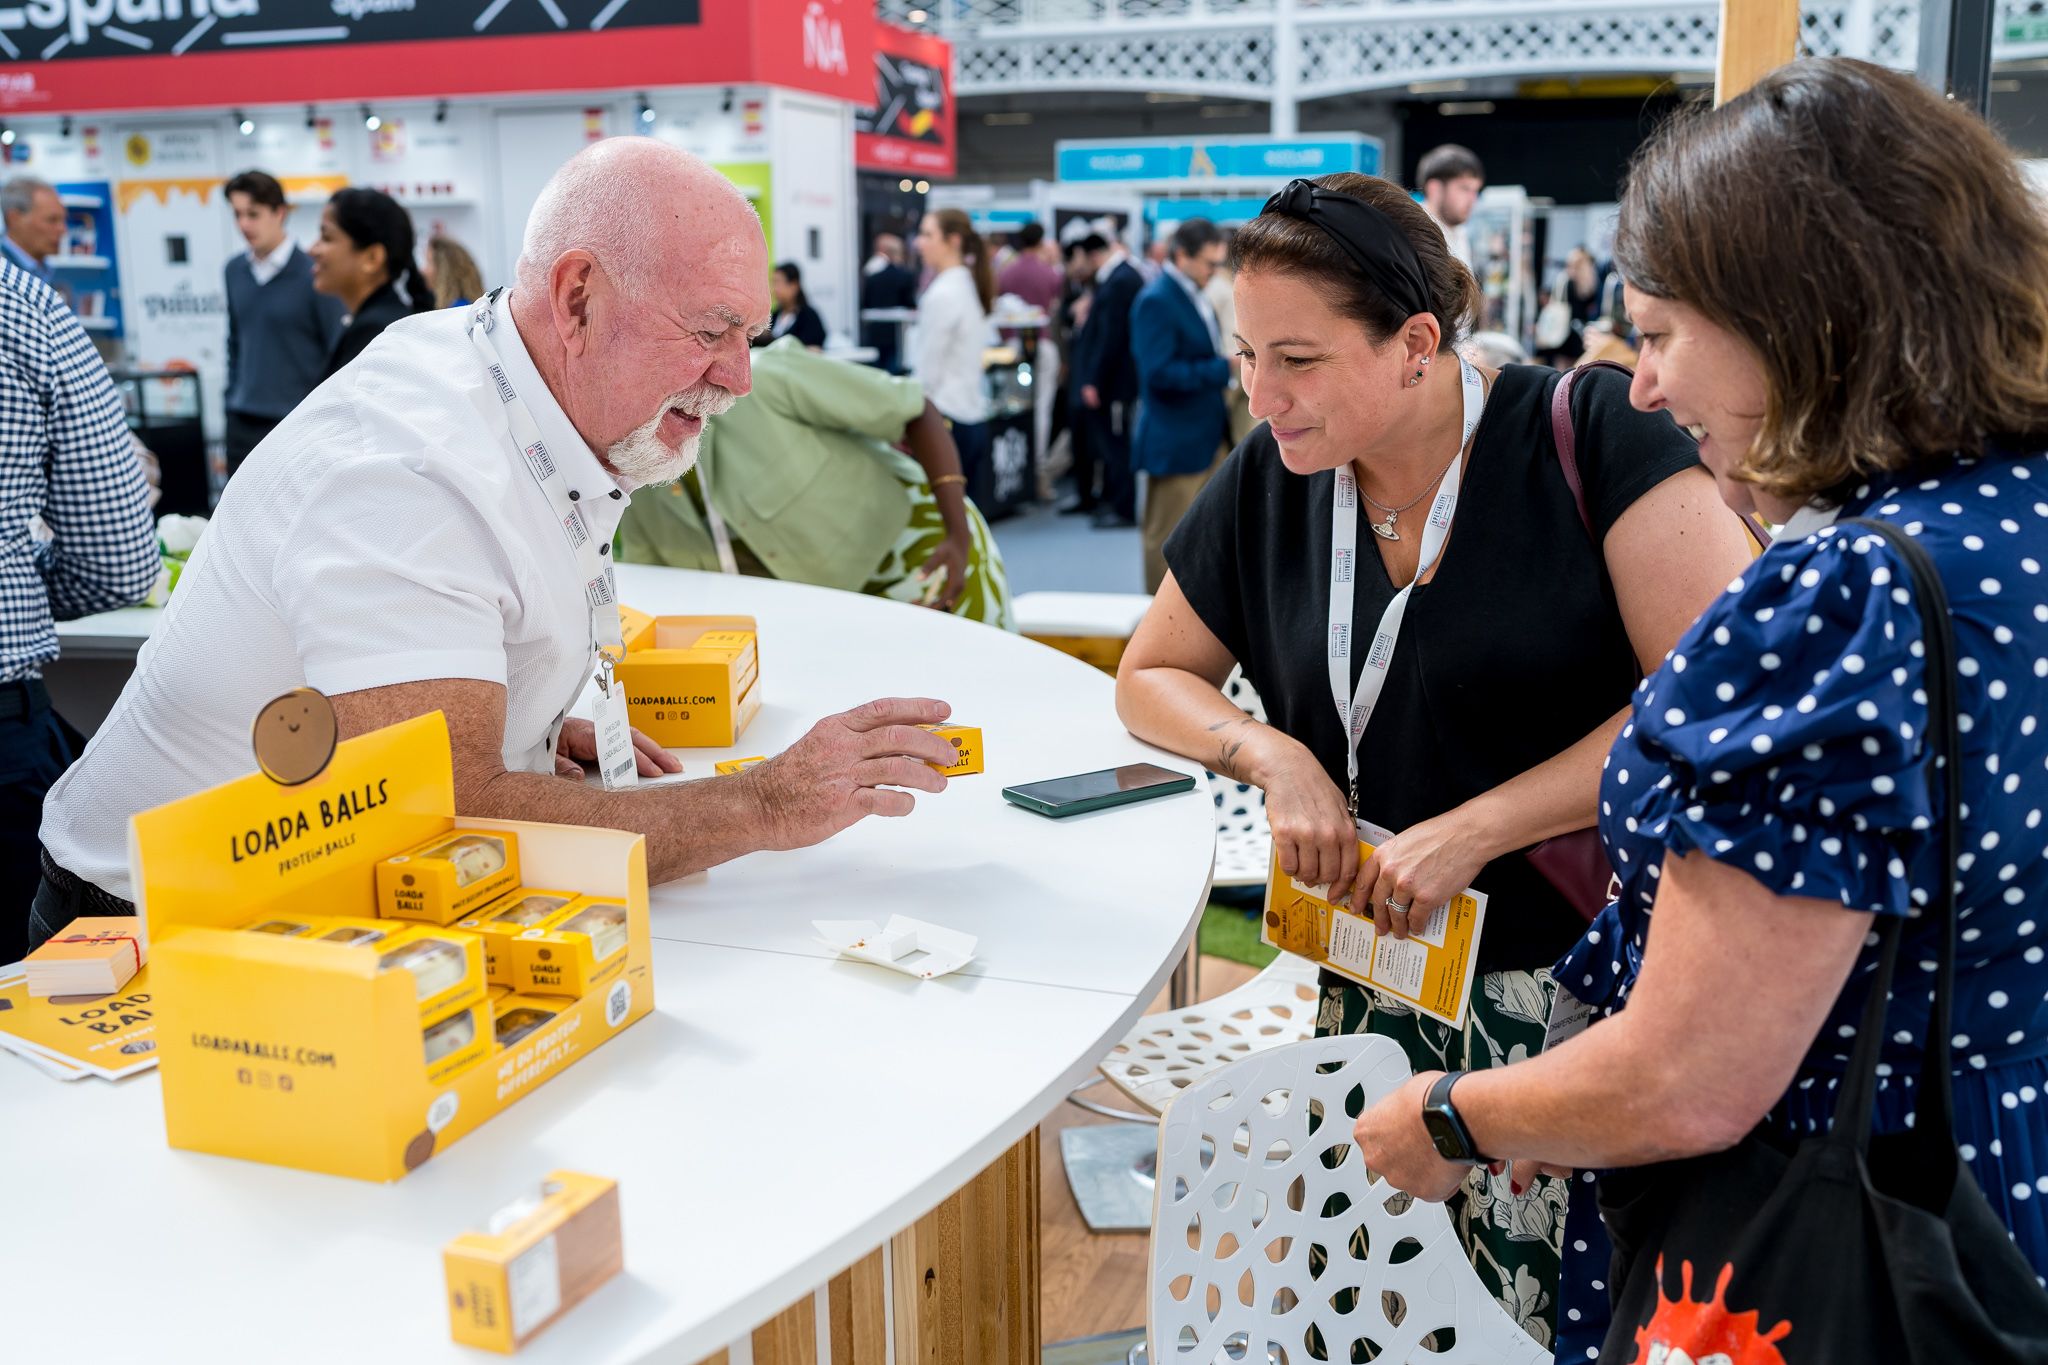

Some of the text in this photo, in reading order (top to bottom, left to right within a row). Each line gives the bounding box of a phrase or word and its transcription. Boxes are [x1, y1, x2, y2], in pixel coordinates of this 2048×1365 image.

[492, 366, 515, 399] SPECIALITY
[534, 443, 555, 474] SPECIALITY
[1431, 496, 1448, 525] SPECIALITY
[570, 513, 587, 541] SPECIALITY
[1344, 551, 1352, 581] SPECIALITY
[1370, 634, 1385, 666] SPECIALITY
[628, 696, 716, 705] LOADABALLS.COM
[231, 778, 388, 863] LOADA BALLS
[278, 832, 356, 876] PROTEIN BALLS
[396, 900, 424, 911] BALLS
[532, 974, 561, 985] BALLS
[59, 993, 152, 1026] LOAD
[191, 1031, 337, 1069] LOADABALLS.COM
[535, 1013, 581, 1057] PROTEIN
